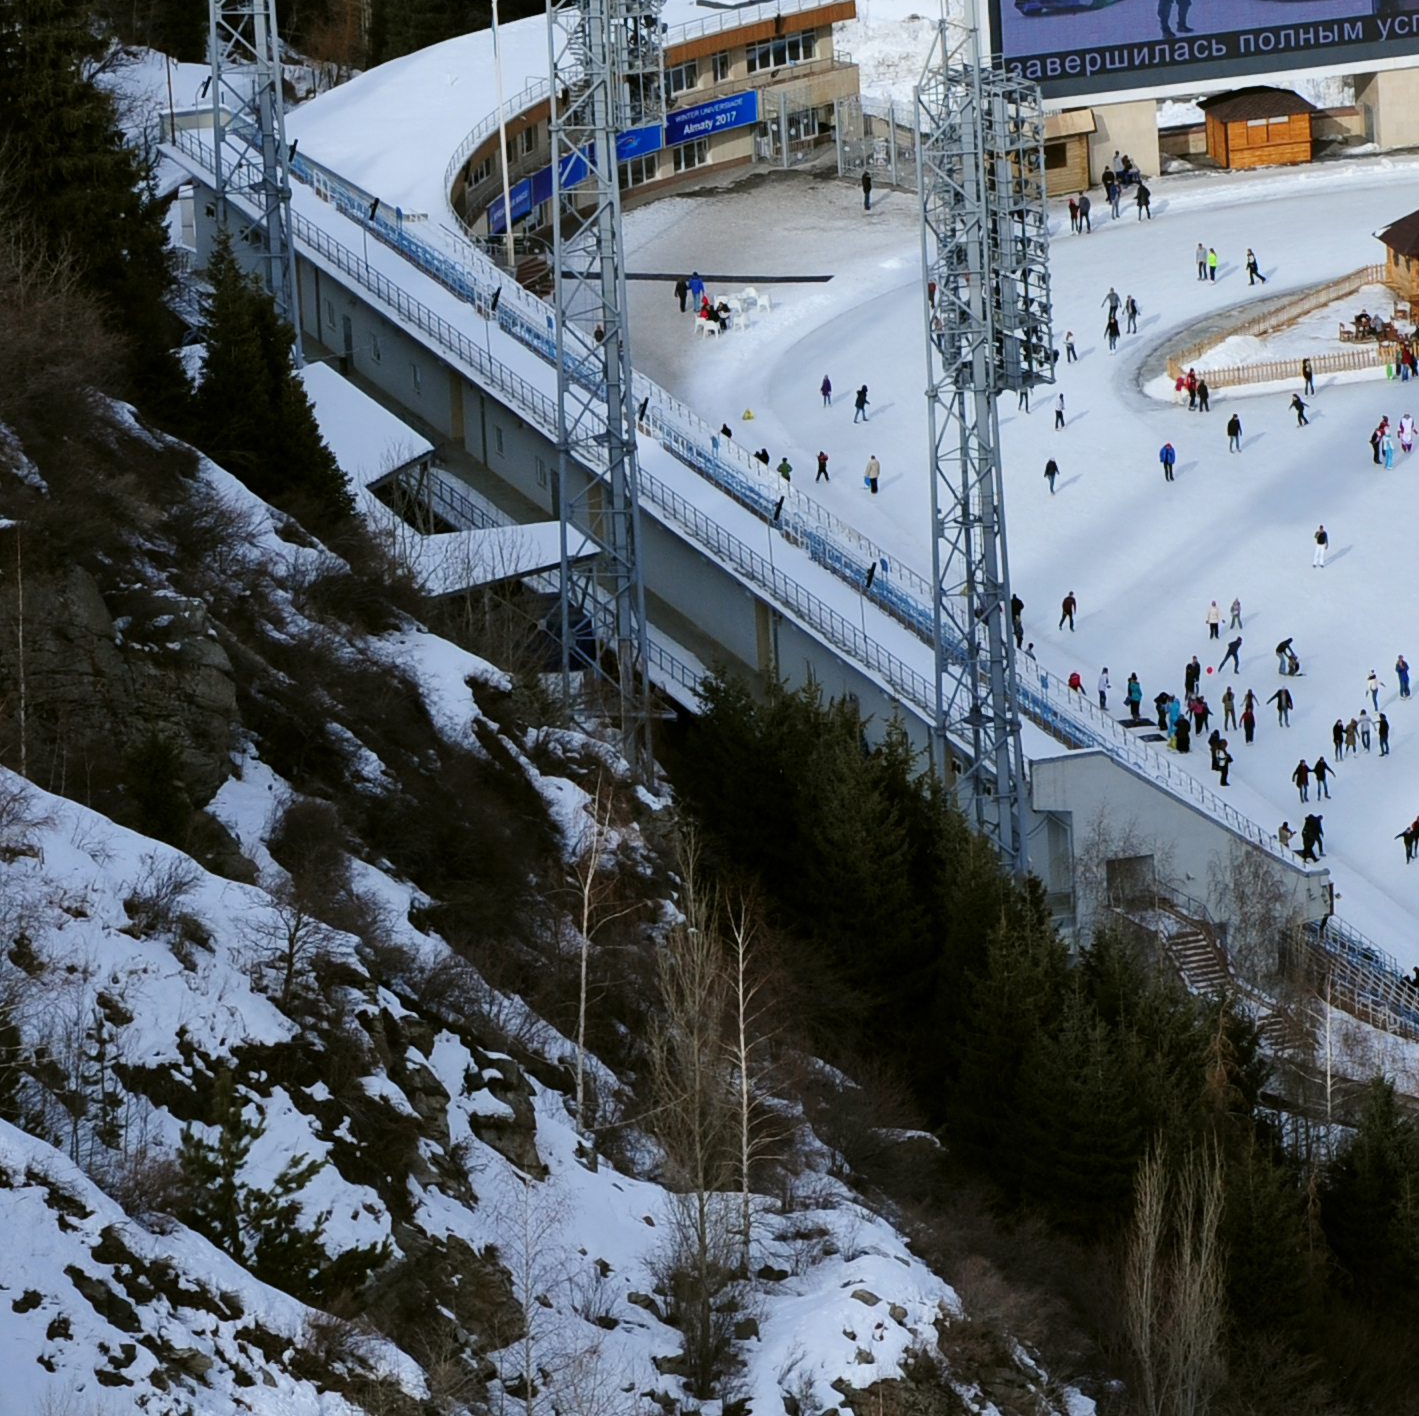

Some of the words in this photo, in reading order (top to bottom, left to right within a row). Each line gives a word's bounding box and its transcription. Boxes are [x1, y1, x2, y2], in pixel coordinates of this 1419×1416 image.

[1010, 38, 1227, 79] завершилась
[1239, 21, 1364, 53] полным
[683, 119, 713, 135] Almaty
[715, 111, 737, 126] 2017
